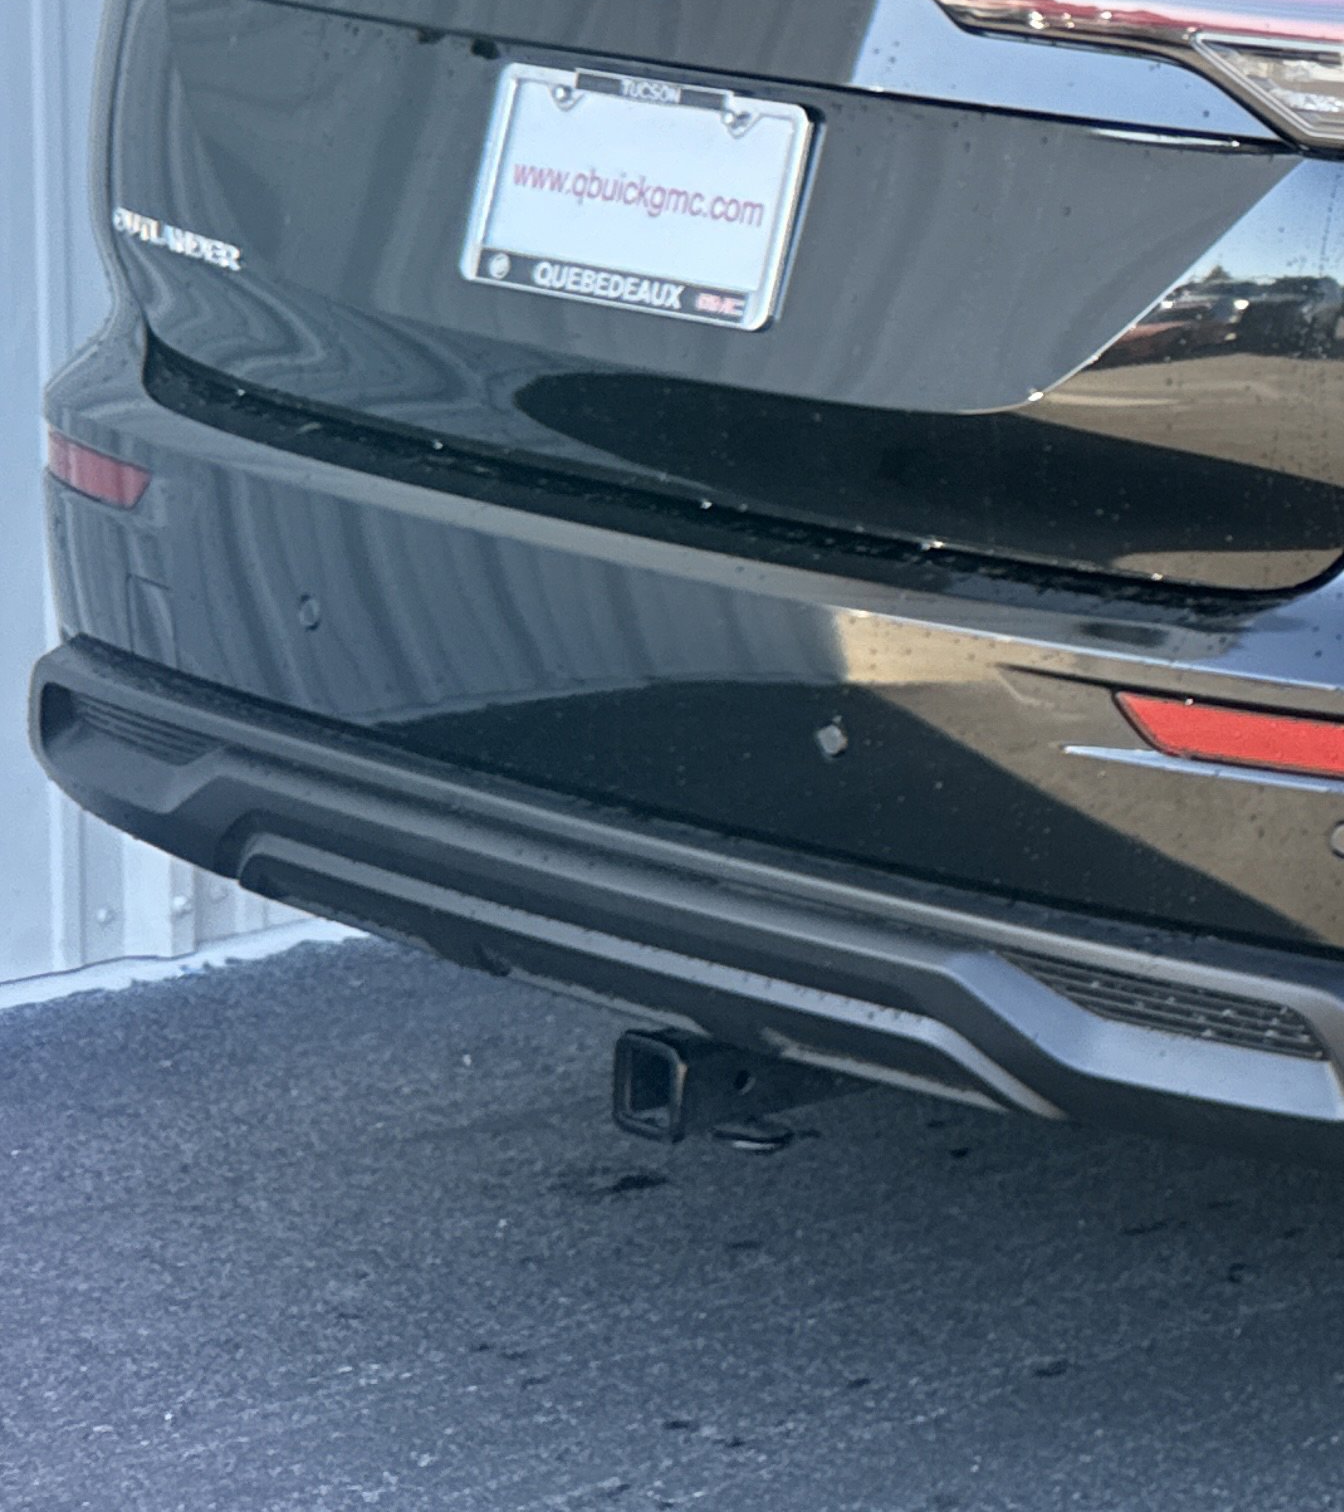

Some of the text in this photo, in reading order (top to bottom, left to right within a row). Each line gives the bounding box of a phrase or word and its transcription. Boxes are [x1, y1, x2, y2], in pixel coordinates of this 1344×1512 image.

[620, 77, 682, 105] TUCSON
[512, 162, 765, 228] www.qbuickgmc.com
[532, 260, 685, 311] QUEBEDEAUX
